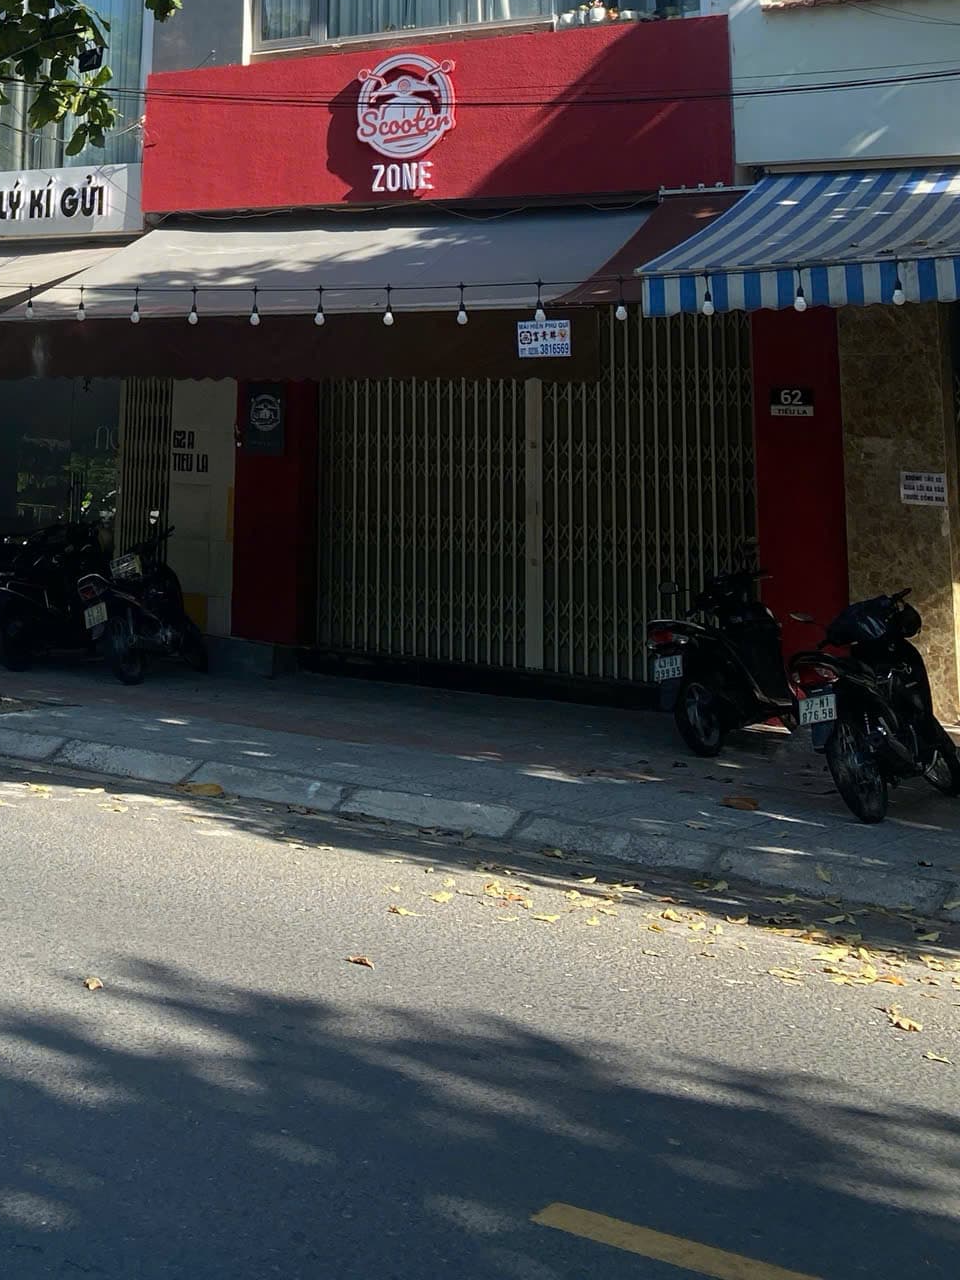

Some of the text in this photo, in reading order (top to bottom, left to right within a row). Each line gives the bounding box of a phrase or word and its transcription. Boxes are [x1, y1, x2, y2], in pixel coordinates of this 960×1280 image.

[359, 107, 451, 138] Scooter
[372, 161, 434, 192] ZONE
[30, 177, 55, 218] KÍ
[60, 175, 106, 217] GỬI
[780, 389, 803, 405] 62
